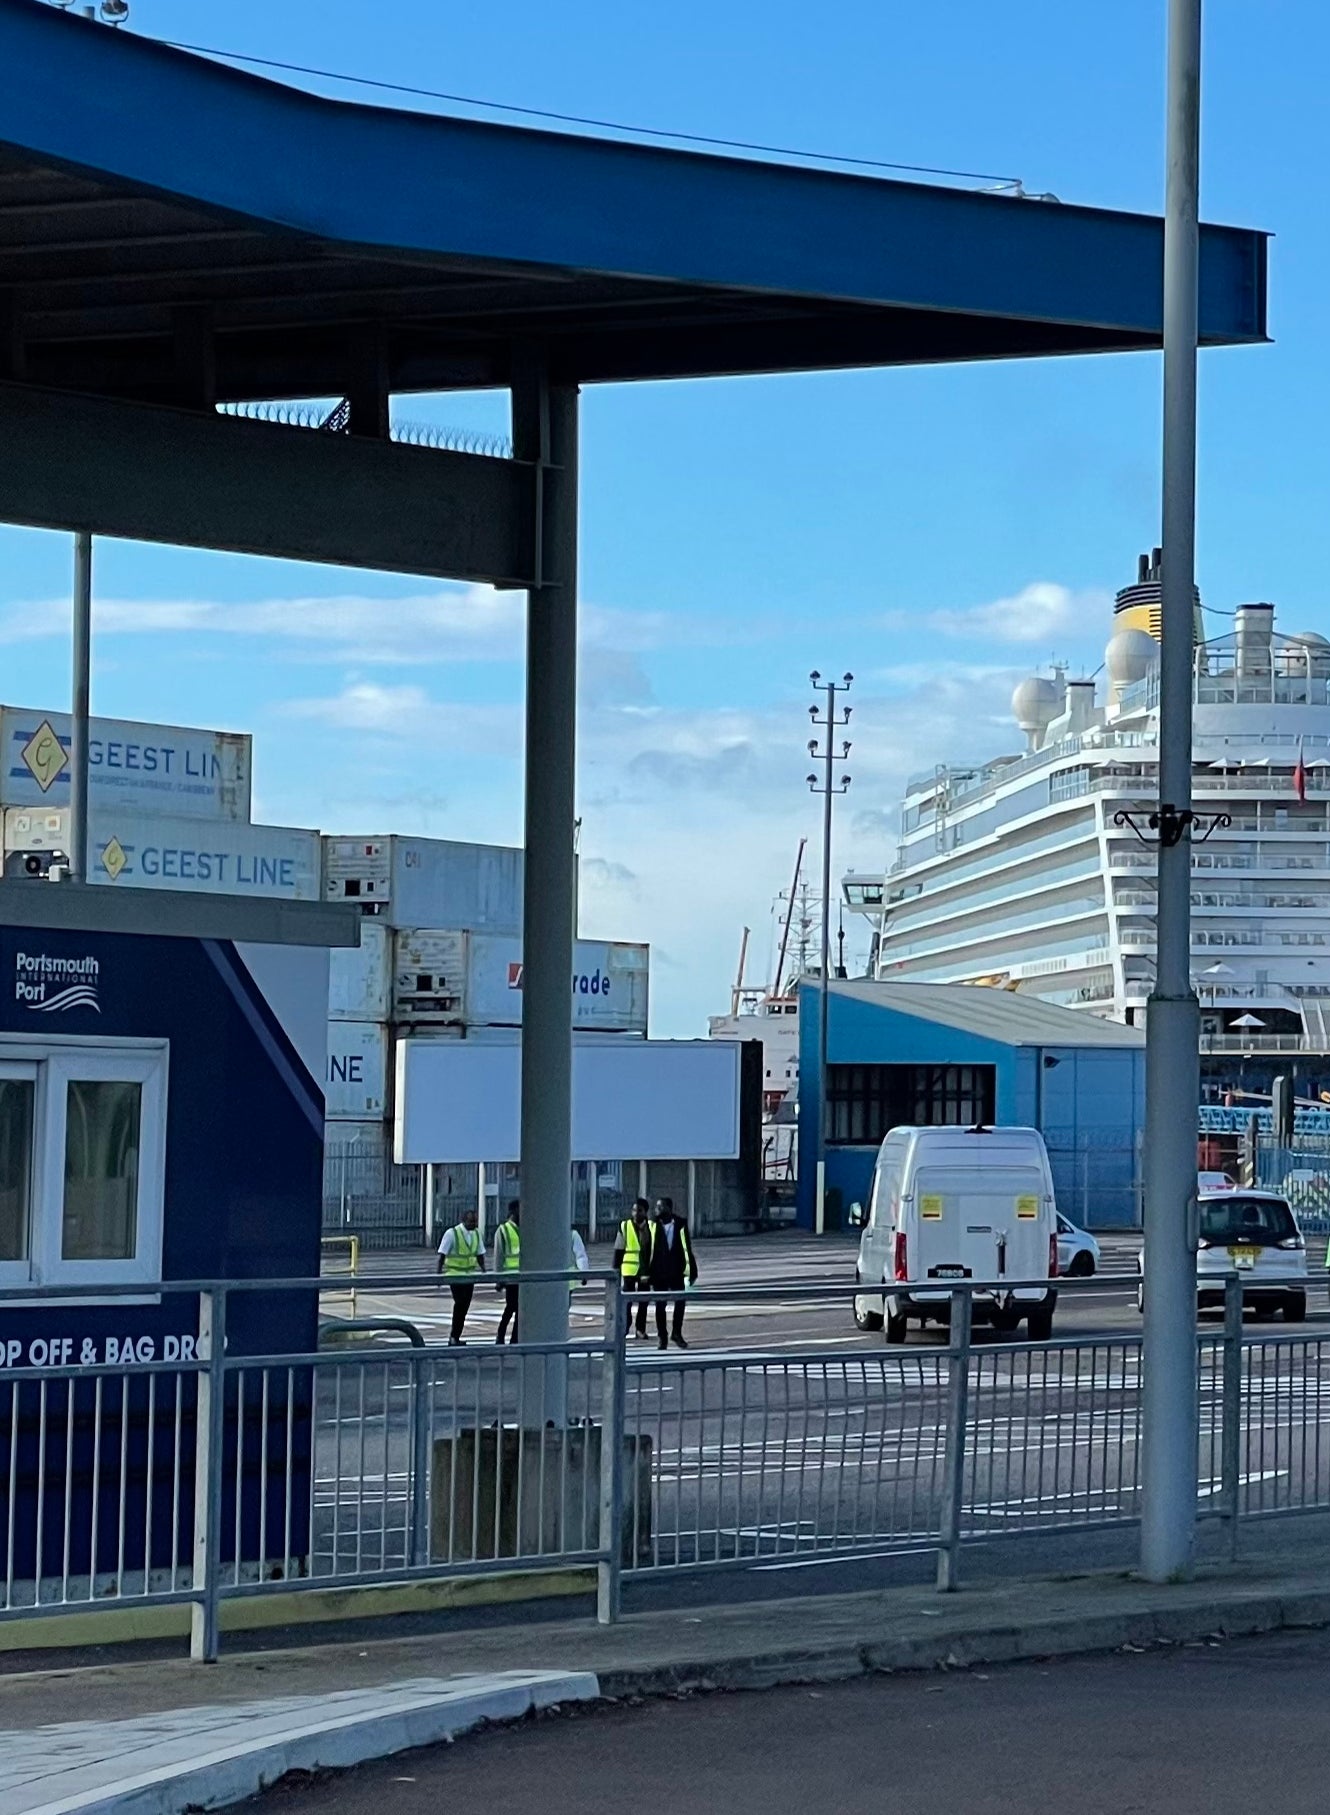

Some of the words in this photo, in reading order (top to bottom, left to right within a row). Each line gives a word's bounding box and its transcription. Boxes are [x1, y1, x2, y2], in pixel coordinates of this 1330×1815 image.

[88, 740, 175, 774] GEEST
[141, 848, 228, 882] GEEST
[237, 855, 295, 886] LINE
[16, 952, 99, 974] Portsmouth
[16, 972, 98, 984] INTERNATIONAL
[572, 969, 610, 995] rade
[16, 982, 45, 1001] Port
[29, 1338, 72, 1366] OFF
[80, 1337, 97, 1364] &
[105, 1335, 155, 1363] BAG
